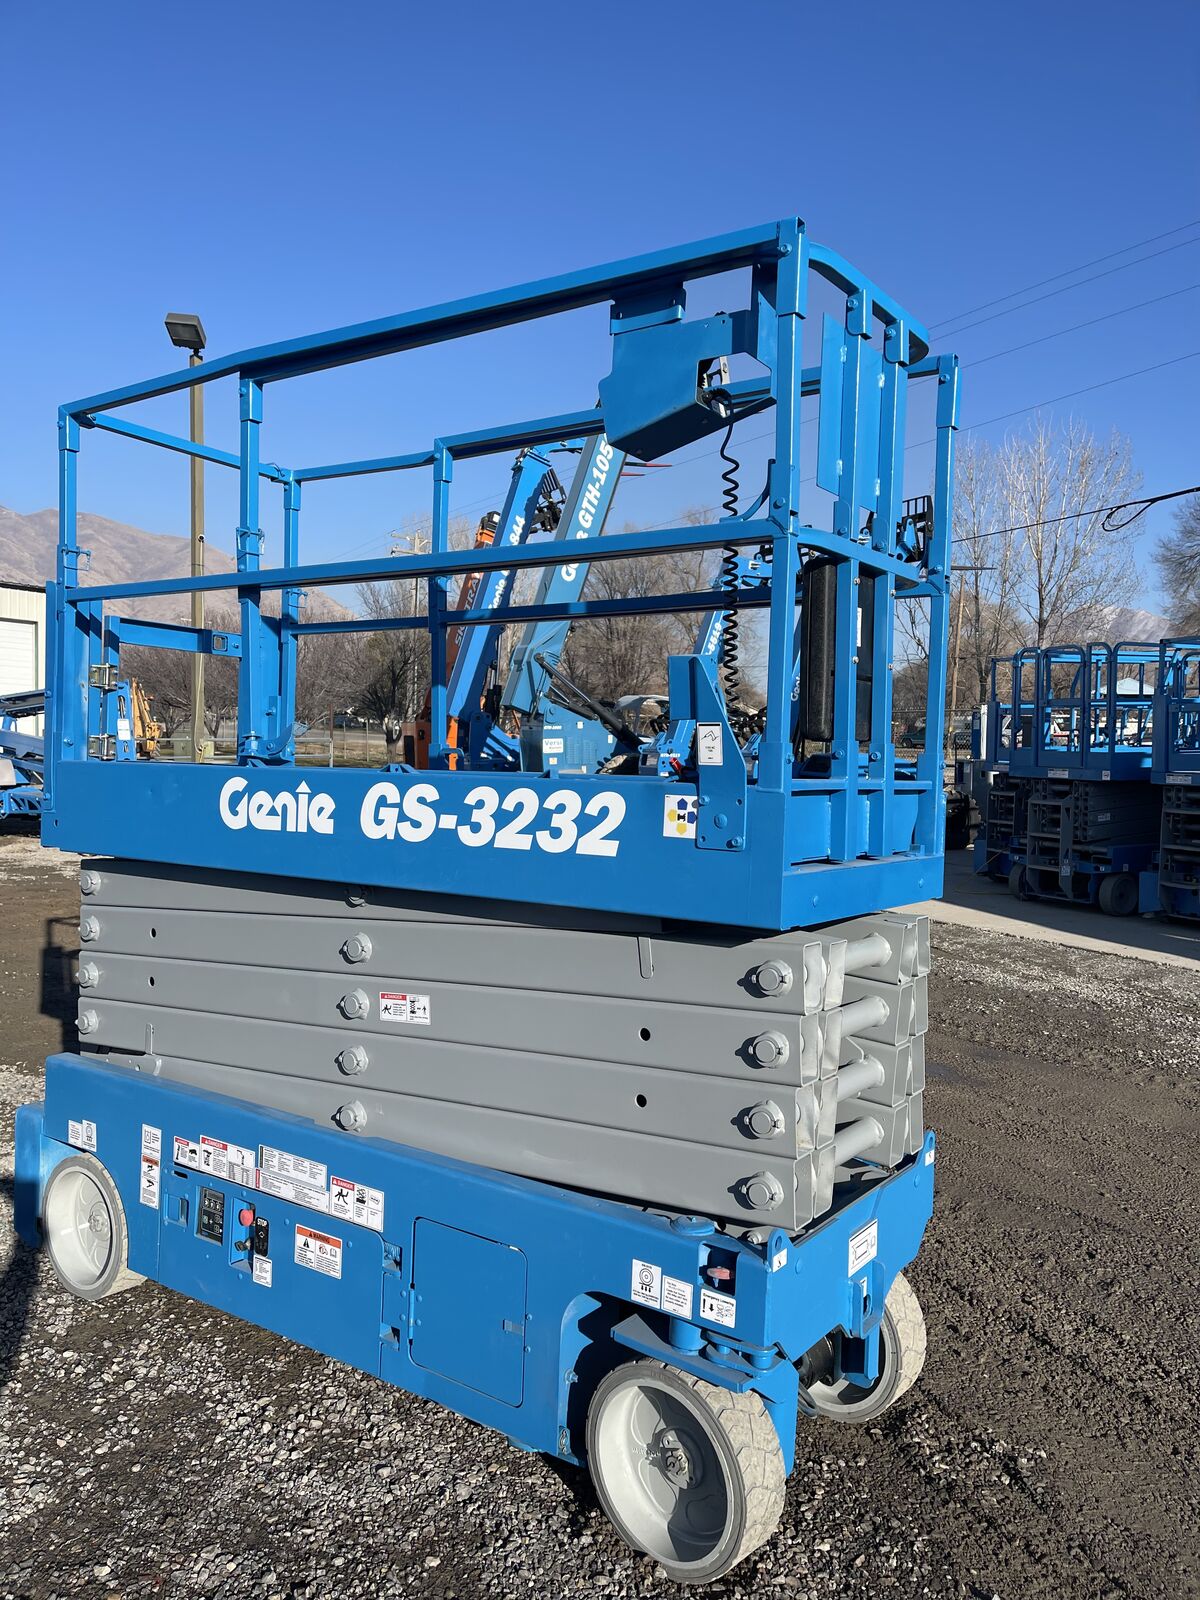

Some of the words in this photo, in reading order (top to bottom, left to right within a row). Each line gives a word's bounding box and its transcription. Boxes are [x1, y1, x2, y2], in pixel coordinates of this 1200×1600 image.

[578, 433, 614, 529] GTH-105
[220, 777, 335, 834] Genie
[361, 782, 626, 856] GS-3232
[337, 1179, 354, 1190] DANGER
[257, 1218, 267, 1227] STOP
